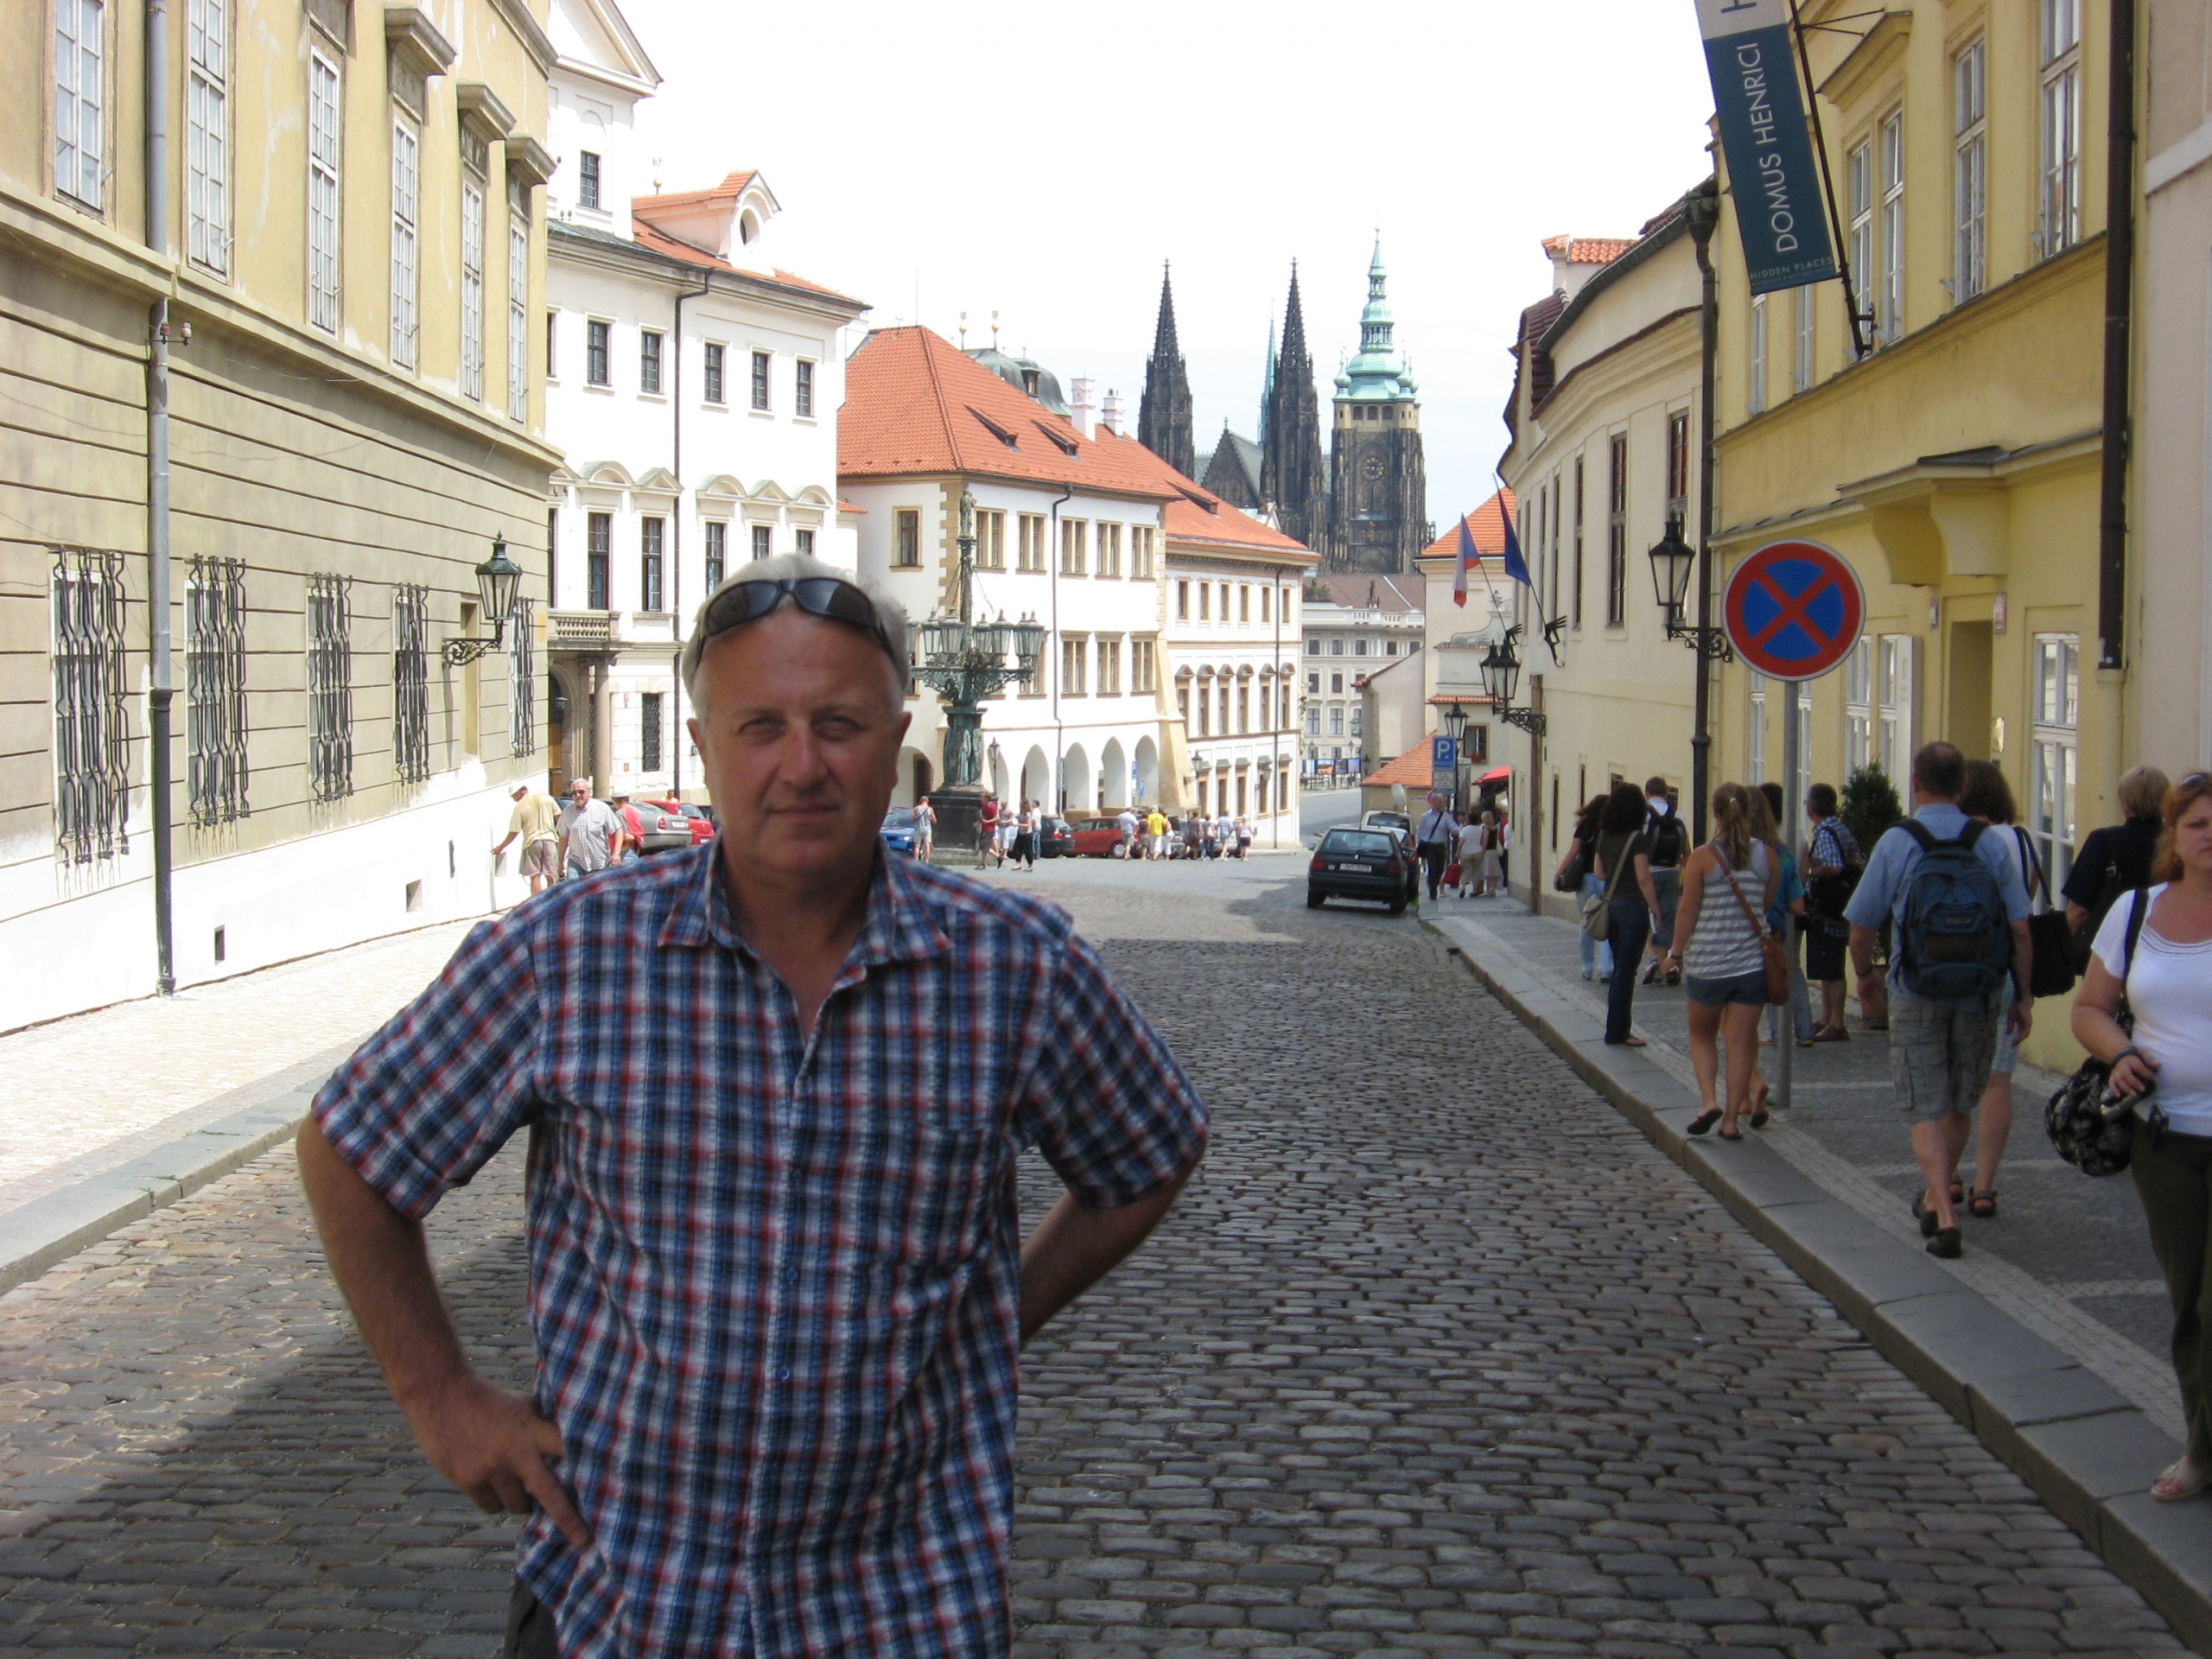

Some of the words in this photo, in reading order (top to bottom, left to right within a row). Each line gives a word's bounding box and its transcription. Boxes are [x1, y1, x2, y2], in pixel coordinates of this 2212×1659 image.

[1737, 43, 1777, 145] HENRICI
[1759, 154, 1798, 252] DOMUS
[1751, 265, 1790, 279] HIDDEN
[1795, 256, 1833, 270] PLACES
[1437, 741, 1450, 759] P
